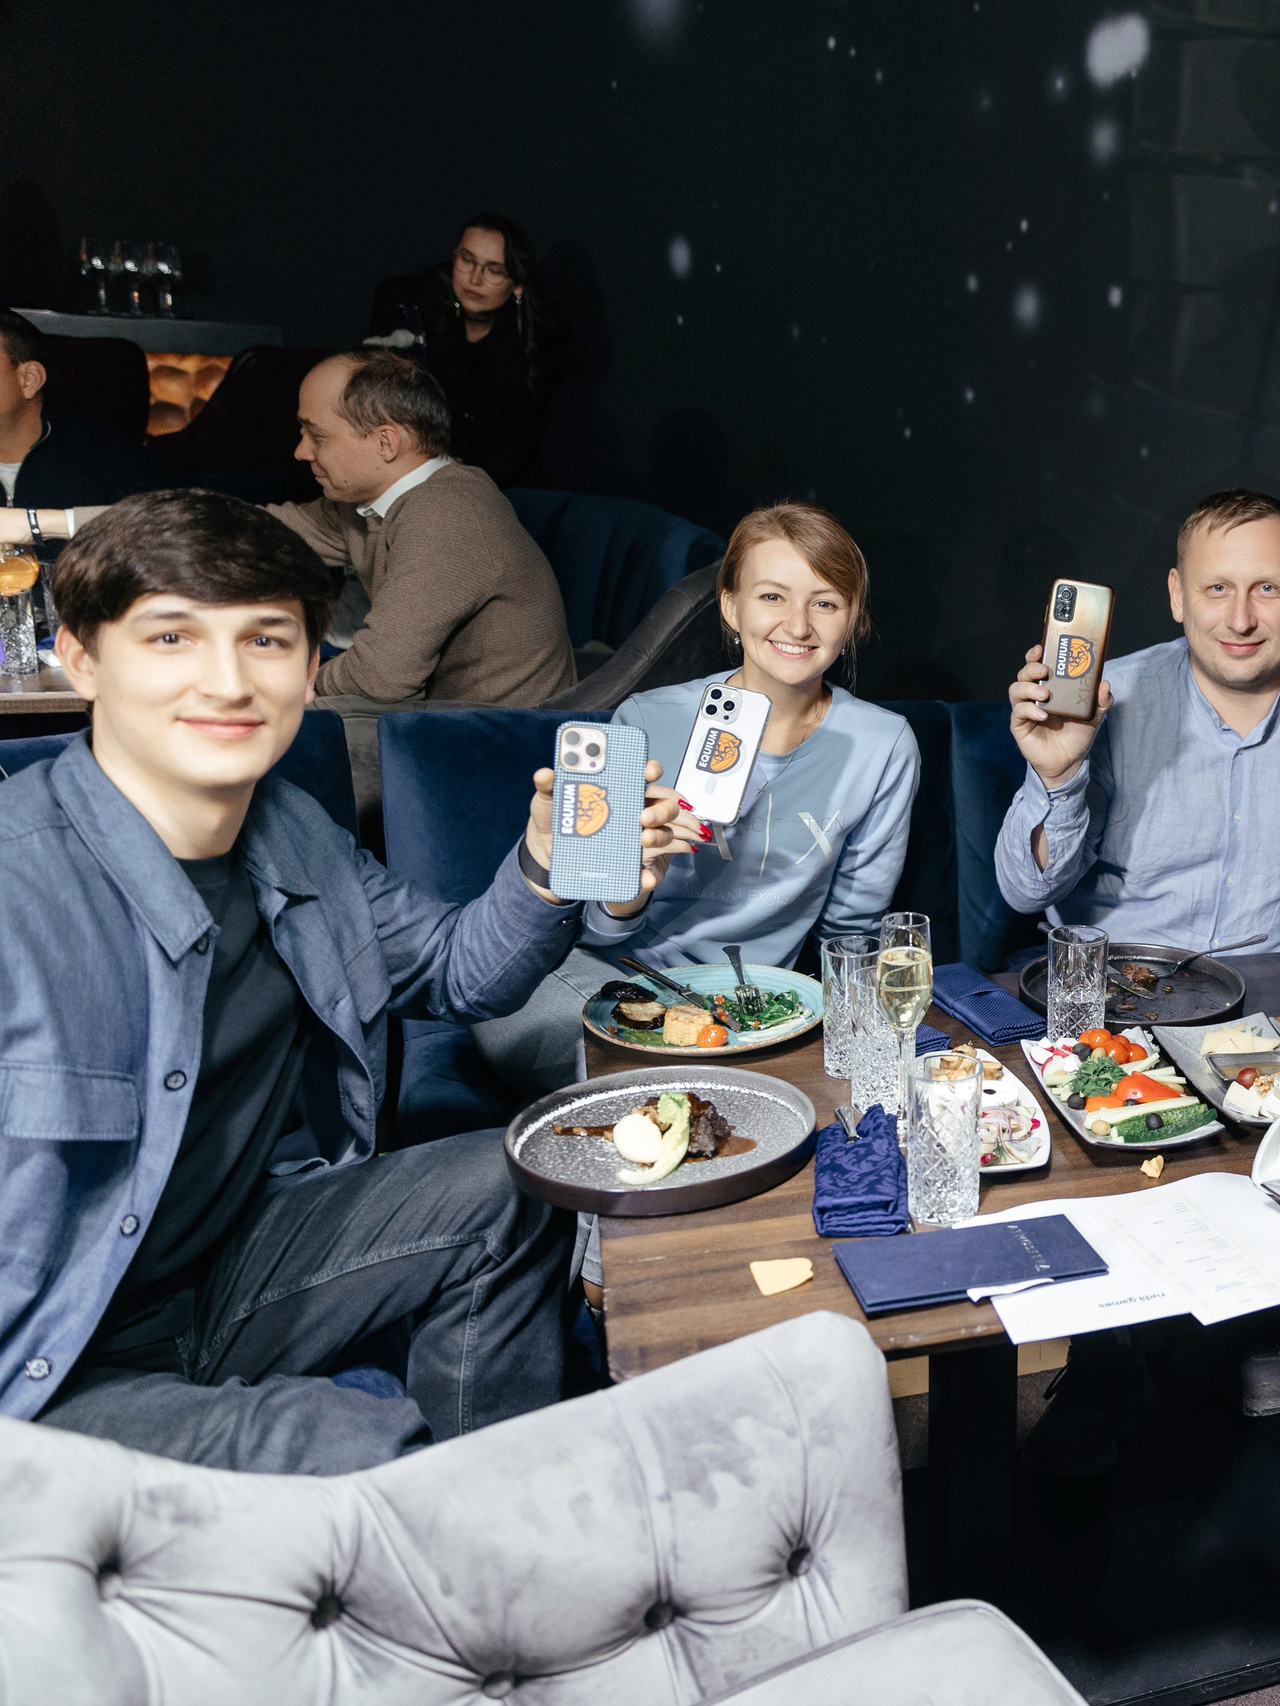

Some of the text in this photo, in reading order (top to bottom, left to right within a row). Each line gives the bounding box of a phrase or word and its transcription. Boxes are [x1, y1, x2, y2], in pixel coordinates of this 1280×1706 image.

[1056, 638, 1069, 676] EQUIUM
[699, 730, 719, 768] EQUIUM
[561, 784, 576, 834] EQUIUM
[1098, 1297, 1137, 1307] games
